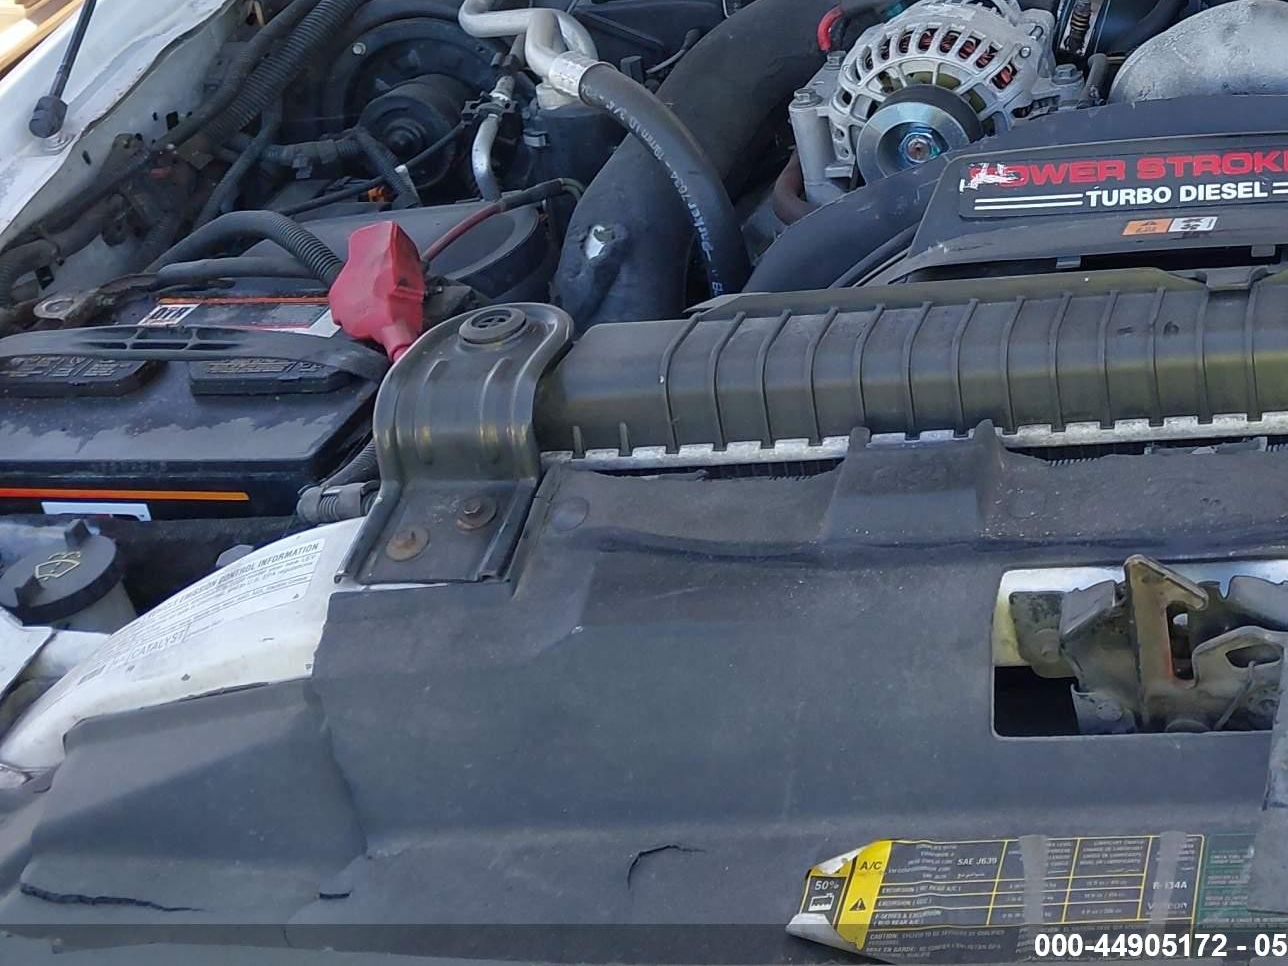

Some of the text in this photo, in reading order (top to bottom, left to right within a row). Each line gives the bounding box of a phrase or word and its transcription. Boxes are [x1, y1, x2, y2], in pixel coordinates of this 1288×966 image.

[1086, 180, 1269, 208] TURBO DIESEL
[219, 563, 256, 584] CONTROL
[257, 542, 320, 568] INFORMATION
[132, 630, 184, 658] CATALYST
[860, 860, 883, 871] A/C
[957, 857, 998, 866] SAE J639
[814, 880, 840, 891] 50%
